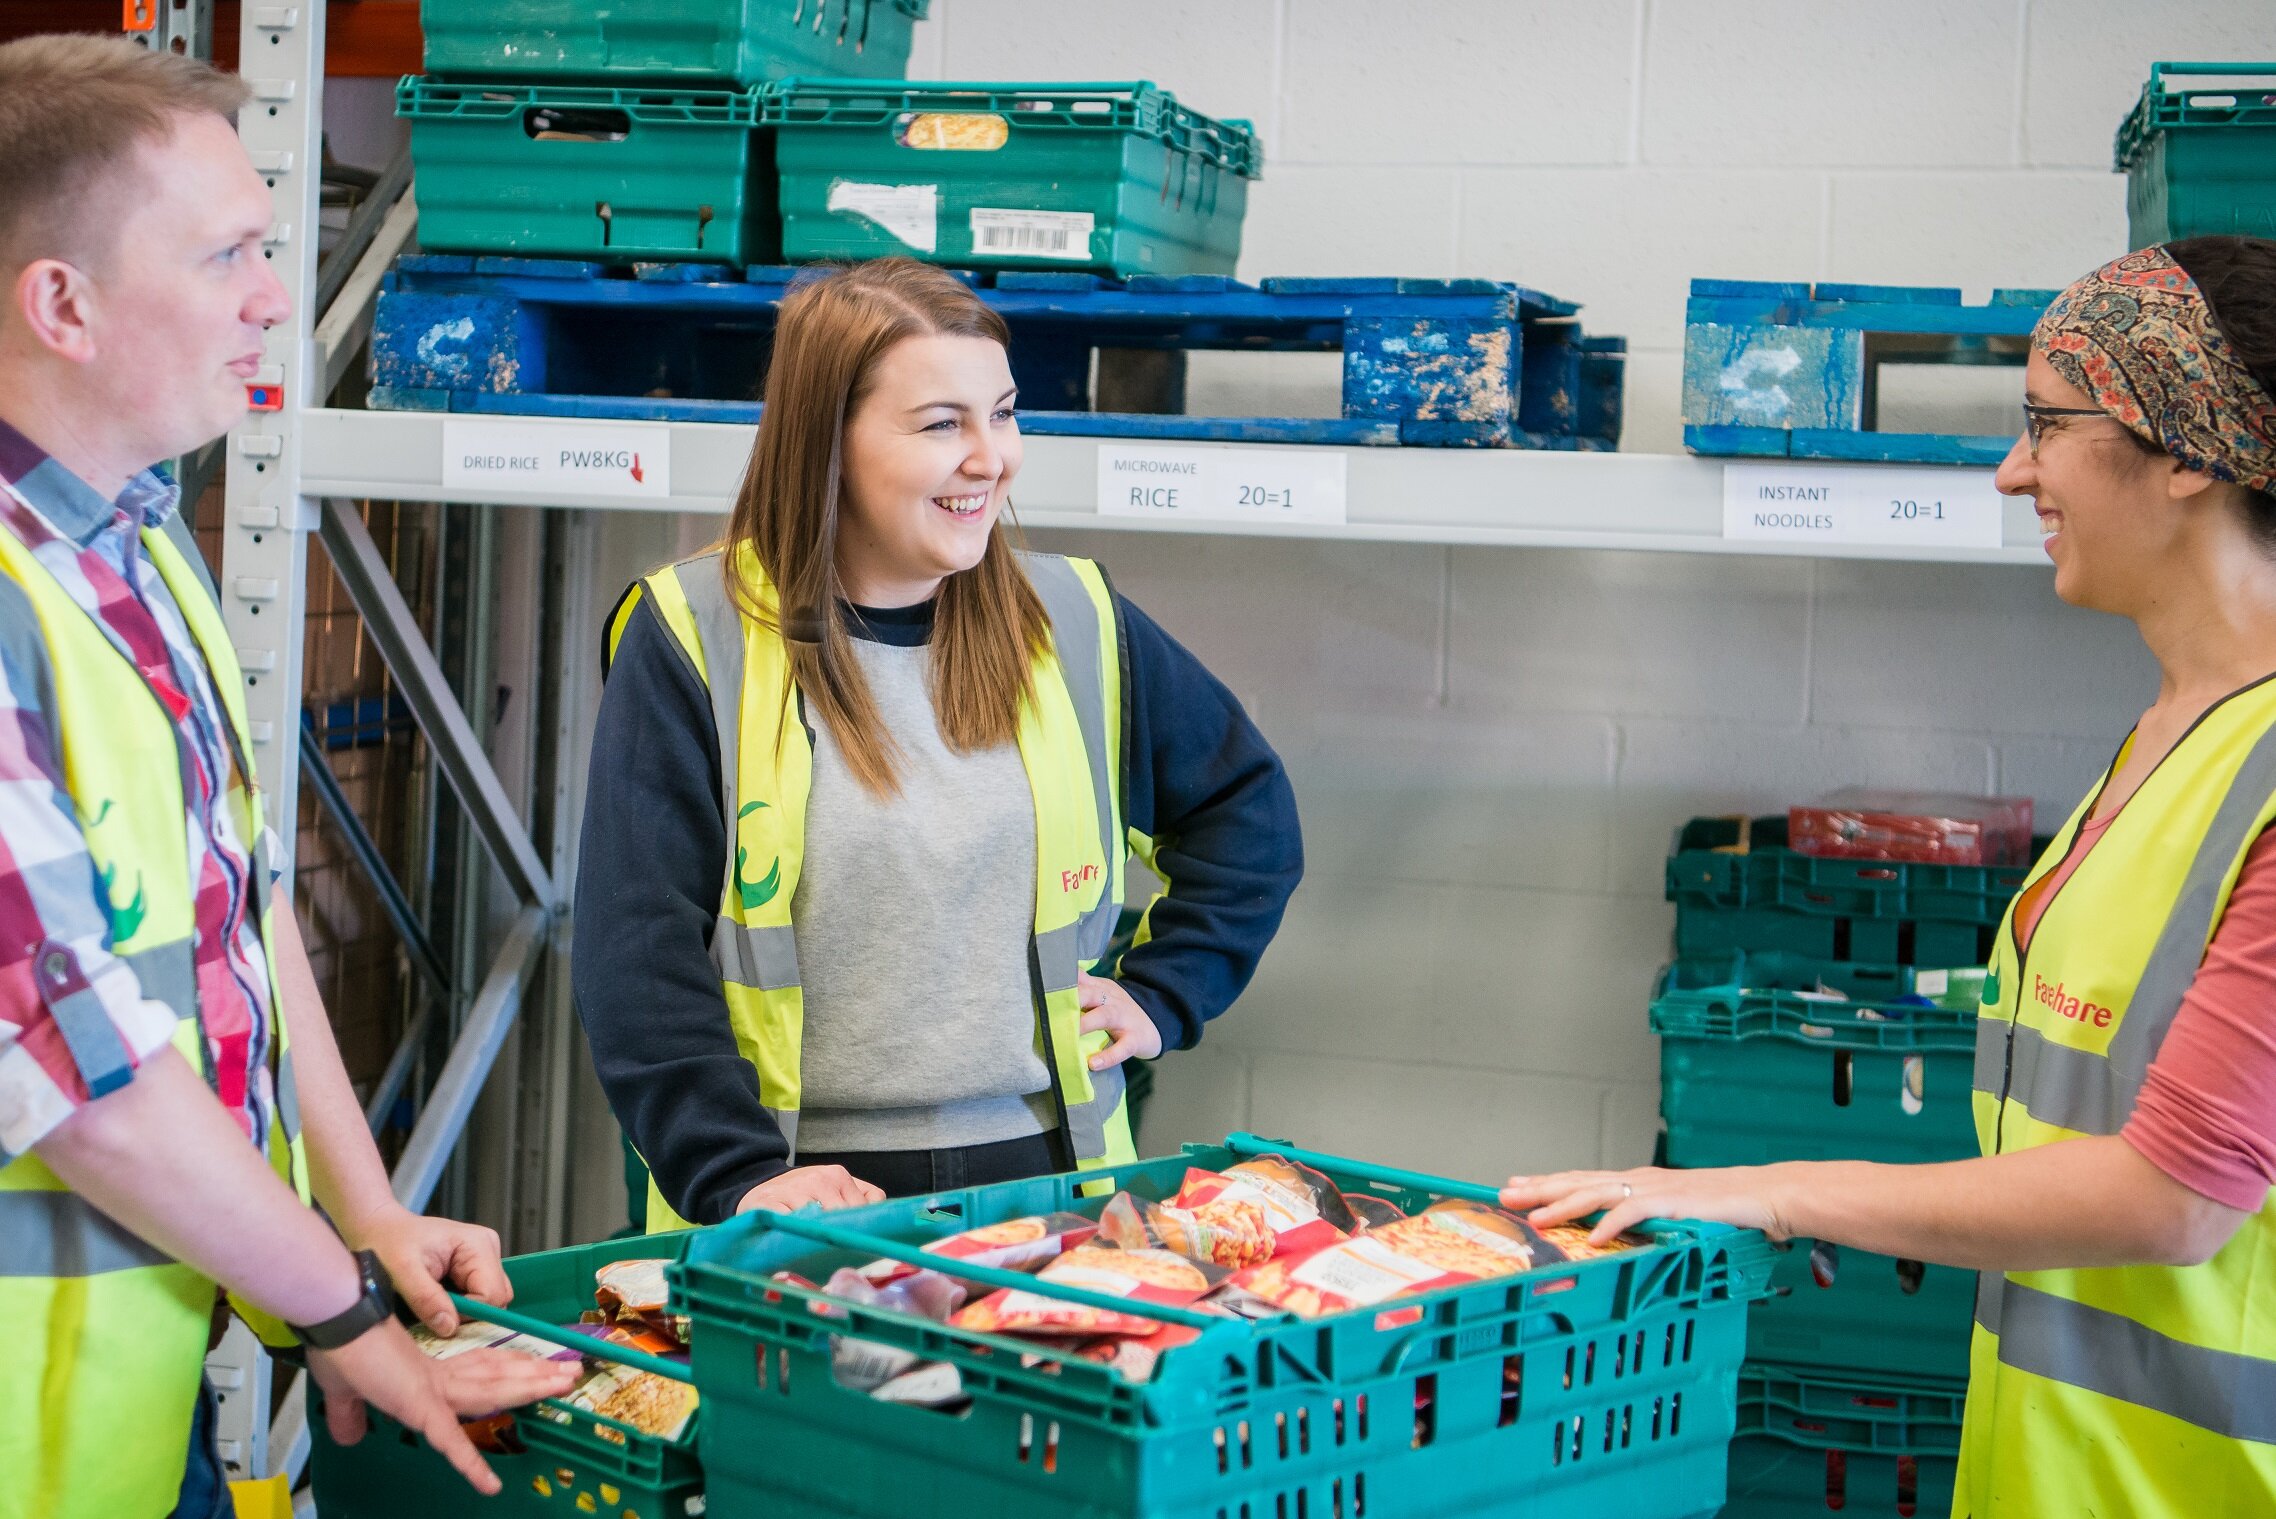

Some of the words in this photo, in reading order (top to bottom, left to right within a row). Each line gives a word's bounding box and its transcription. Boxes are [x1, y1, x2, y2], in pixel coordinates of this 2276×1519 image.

[463, 455, 506, 470] DRIED
[510, 456, 540, 470] RICE
[560, 450, 630, 468] PW8KG
[1113, 459, 1198, 475] MICROWAVE
[1130, 486, 1179, 508] RICE
[1238, 485, 1294, 508] 20=1
[1759, 485, 1831, 502] INSTANT
[1890, 500, 1946, 520] 20=1
[1754, 513, 1834, 529] NOODLES
